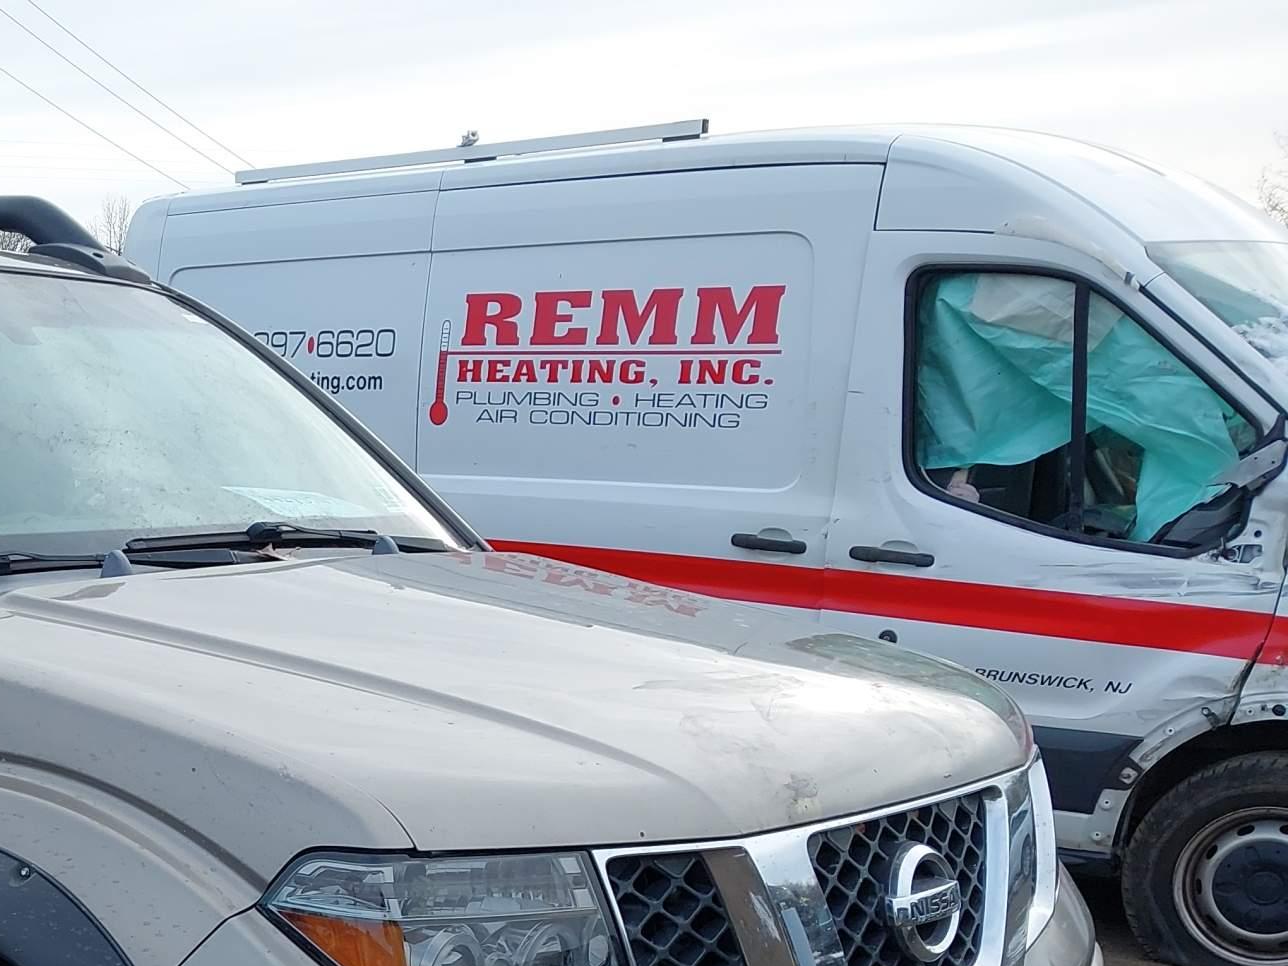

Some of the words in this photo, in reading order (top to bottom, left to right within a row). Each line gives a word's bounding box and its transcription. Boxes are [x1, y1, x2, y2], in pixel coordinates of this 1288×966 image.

[460, 284, 787, 347] REMM
[456, 359, 658, 388] HEATING,
[677, 359, 774, 386] INC.
[455, 390, 600, 407] PLUMBING
[634, 392, 769, 409] HEATING
[475, 409, 518, 424] AIR
[529, 410, 741, 429] CONDITIONING
[1103, 680, 1133, 695] NJ
